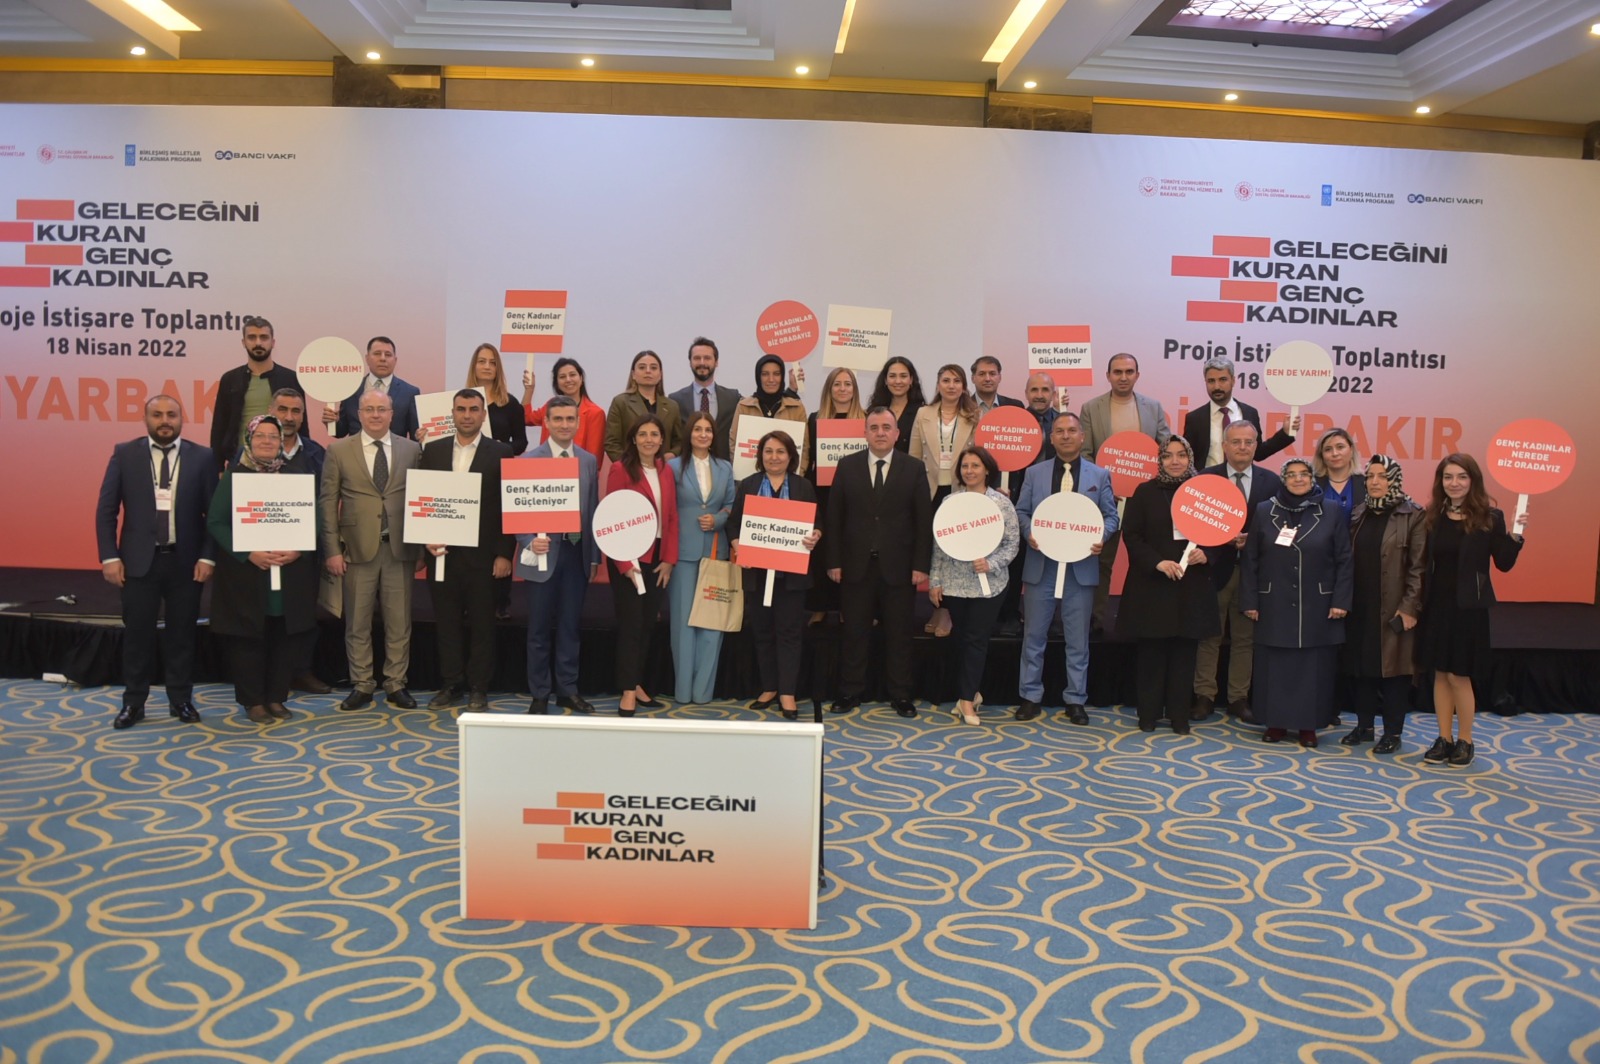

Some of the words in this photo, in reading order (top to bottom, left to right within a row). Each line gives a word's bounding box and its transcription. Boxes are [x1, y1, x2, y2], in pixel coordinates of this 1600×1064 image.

[78, 200, 259, 222] GELECEĞİNİ
[37, 224, 145, 243] KURAN
[85, 248, 173, 269] GENÇ
[1273, 239, 1448, 264] GELECEĞİNİ
[53, 269, 209, 289] KADINLAR
[1232, 260, 1339, 281] KURAN
[1279, 284, 1365, 307] GENÇ
[0, 305, 35, 331] oje
[43, 300, 134, 332] İstişare
[142, 308, 262, 334] Toplantı
[527, 312, 561, 320] Kadınlar
[760, 322, 778, 332] GENÇ
[779, 314, 813, 327] KADINLAR
[1246, 304, 1398, 328] KADINLAR
[512, 322, 554, 331] Güçleniyor
[774, 326, 801, 336] NEREDE
[47, 337, 69, 354] 18
[76, 338, 132, 356] Nisan
[138, 340, 186, 357] 2022
[767, 338, 778, 347] BİZ
[779, 331, 812, 344] ORADAYIZ
[1038, 357, 1081, 366] Güçleniyor
[1234, 336, 1272, 362] İsti
[1332, 345, 1446, 371] Toplantısı
[1238, 372, 1260, 390] 18
[1327, 376, 1373, 394] 2022
[981, 425, 1000, 433] GENÇ
[1002, 427, 1038, 435] KADINLAR
[820, 443, 841, 452] Genç
[984, 441, 995, 450] BİZ
[997, 444, 1032, 452] ORADAYIZ
[1104, 447, 1123, 457] GENÇ
[1496, 438, 1521, 449] GENÇ
[1523, 441, 1571, 454] KADINLAR
[1115, 458, 1144, 469] NEREDE
[1512, 450, 1549, 461] NEREDE
[1117, 468, 1152, 480] ORADAYIZ
[1497, 459, 1512, 467] BİZ
[1514, 461, 1560, 473] ORADAYIZ
[506, 485, 530, 495] Genç
[533, 484, 575, 493] Kadınlar
[514, 497, 567, 507] Güçleniyor
[1185, 486, 1205, 502] GENÇ
[1205, 495, 1244, 518] KADINLAR
[1193, 500, 1224, 520] NEREDE
[596, 526, 613, 538] BEN
[614, 522, 625, 532] DE
[626, 512, 654, 527] VARIM!
[936, 527, 955, 538] BEN
[956, 523, 968, 533] DE
[969, 513, 1001, 529] VARIM!
[1034, 519, 1053, 528] BEN
[1069, 523, 1101, 534] VARIM!
[1180, 503, 1192, 515] BİZ
[1193, 510, 1231, 533] ORADAYIZ
[745, 520, 767, 532] Genç
[769, 523, 809, 536] Kadınlar
[750, 532, 800, 547] Güçleniyor
[607, 795, 756, 812] GELECEĞİNİ
[573, 812, 663, 827] KURAN
[614, 830, 686, 847] GENÇ
[586, 846, 715, 864] KADINLAR
